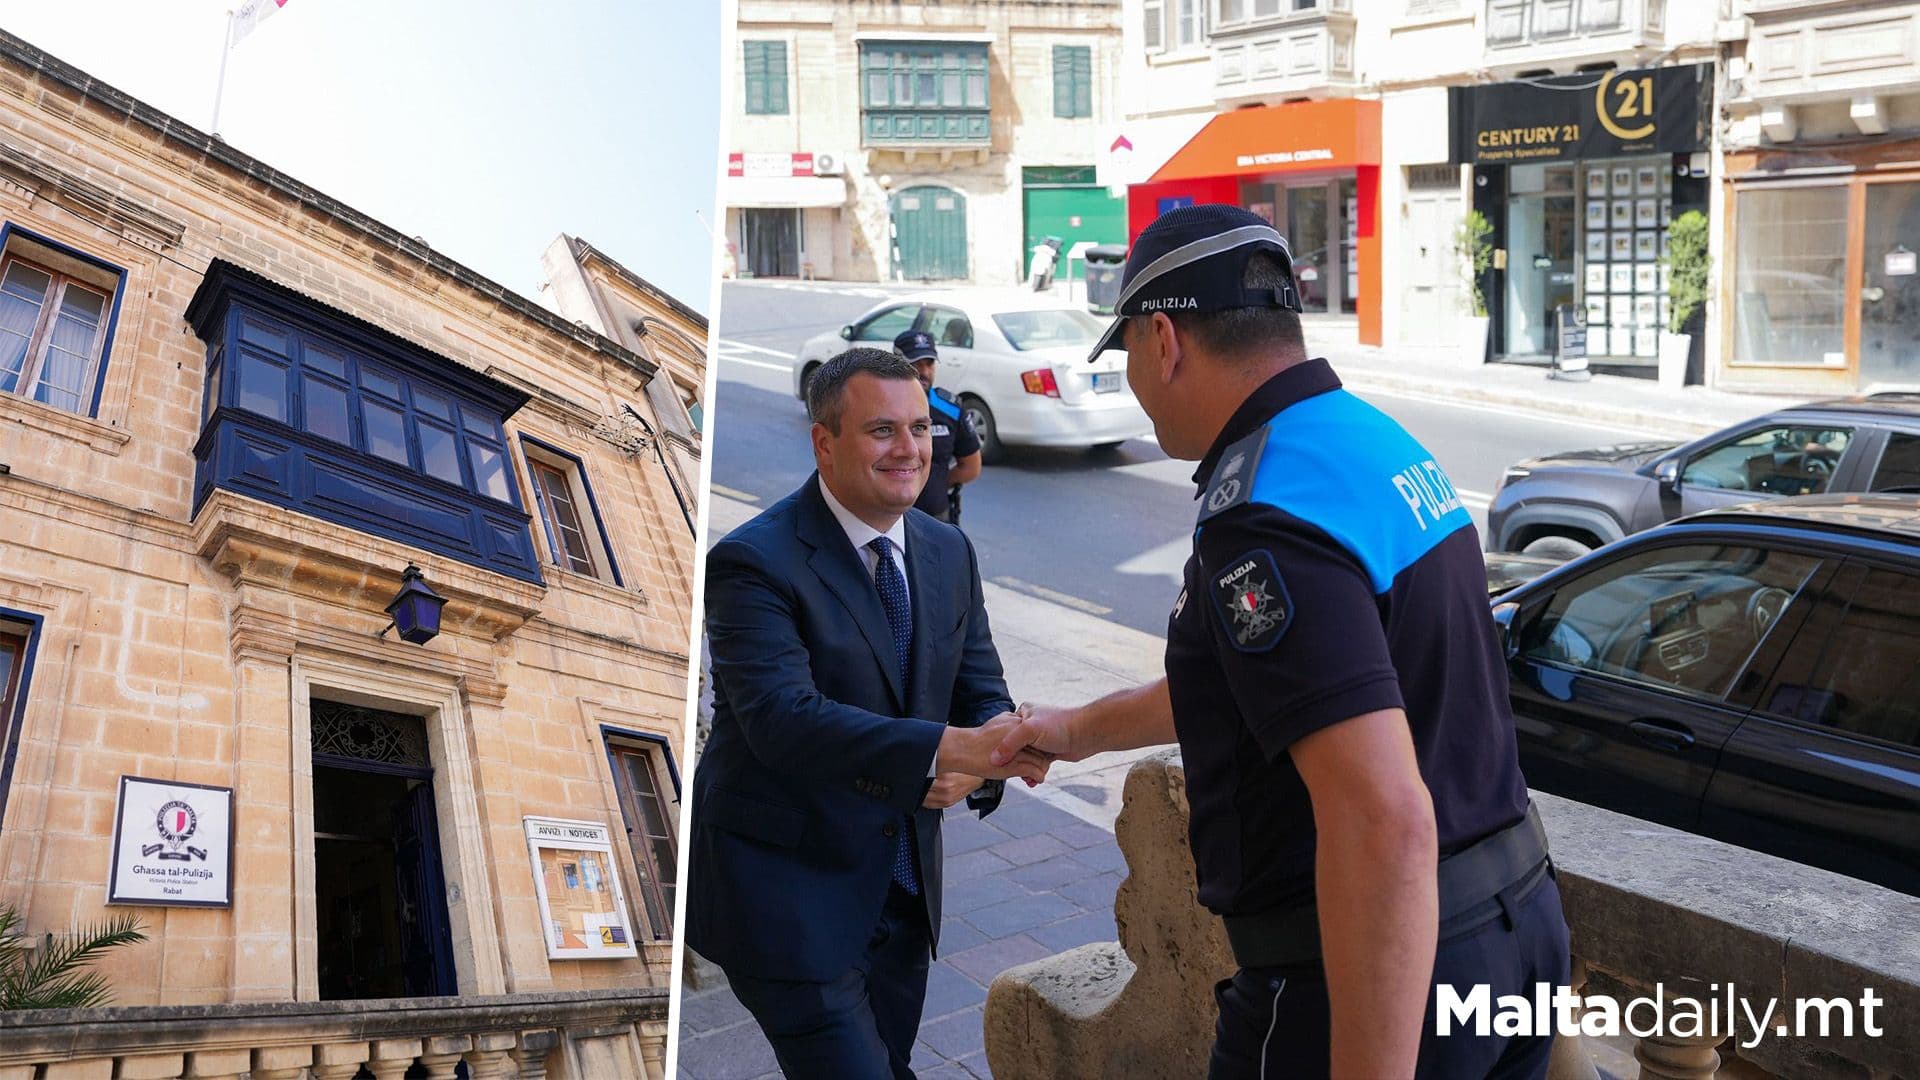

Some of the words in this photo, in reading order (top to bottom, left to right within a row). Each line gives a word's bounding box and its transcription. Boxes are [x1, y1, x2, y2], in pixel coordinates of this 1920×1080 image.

[1477, 126, 1559, 147] CENTURY
[1562, 124, 1579, 142] 21
[1142, 297, 1198, 311] PULIZIJA
[1219, 560, 1257, 588] PULIZIJA
[539, 827, 561, 837] AVVIZI
[568, 829, 599, 839] NOTICES
[133, 865, 166, 875] Għassa
[168, 867, 213, 880] tal-Pulizija
[163, 887, 182, 895] Rabat
